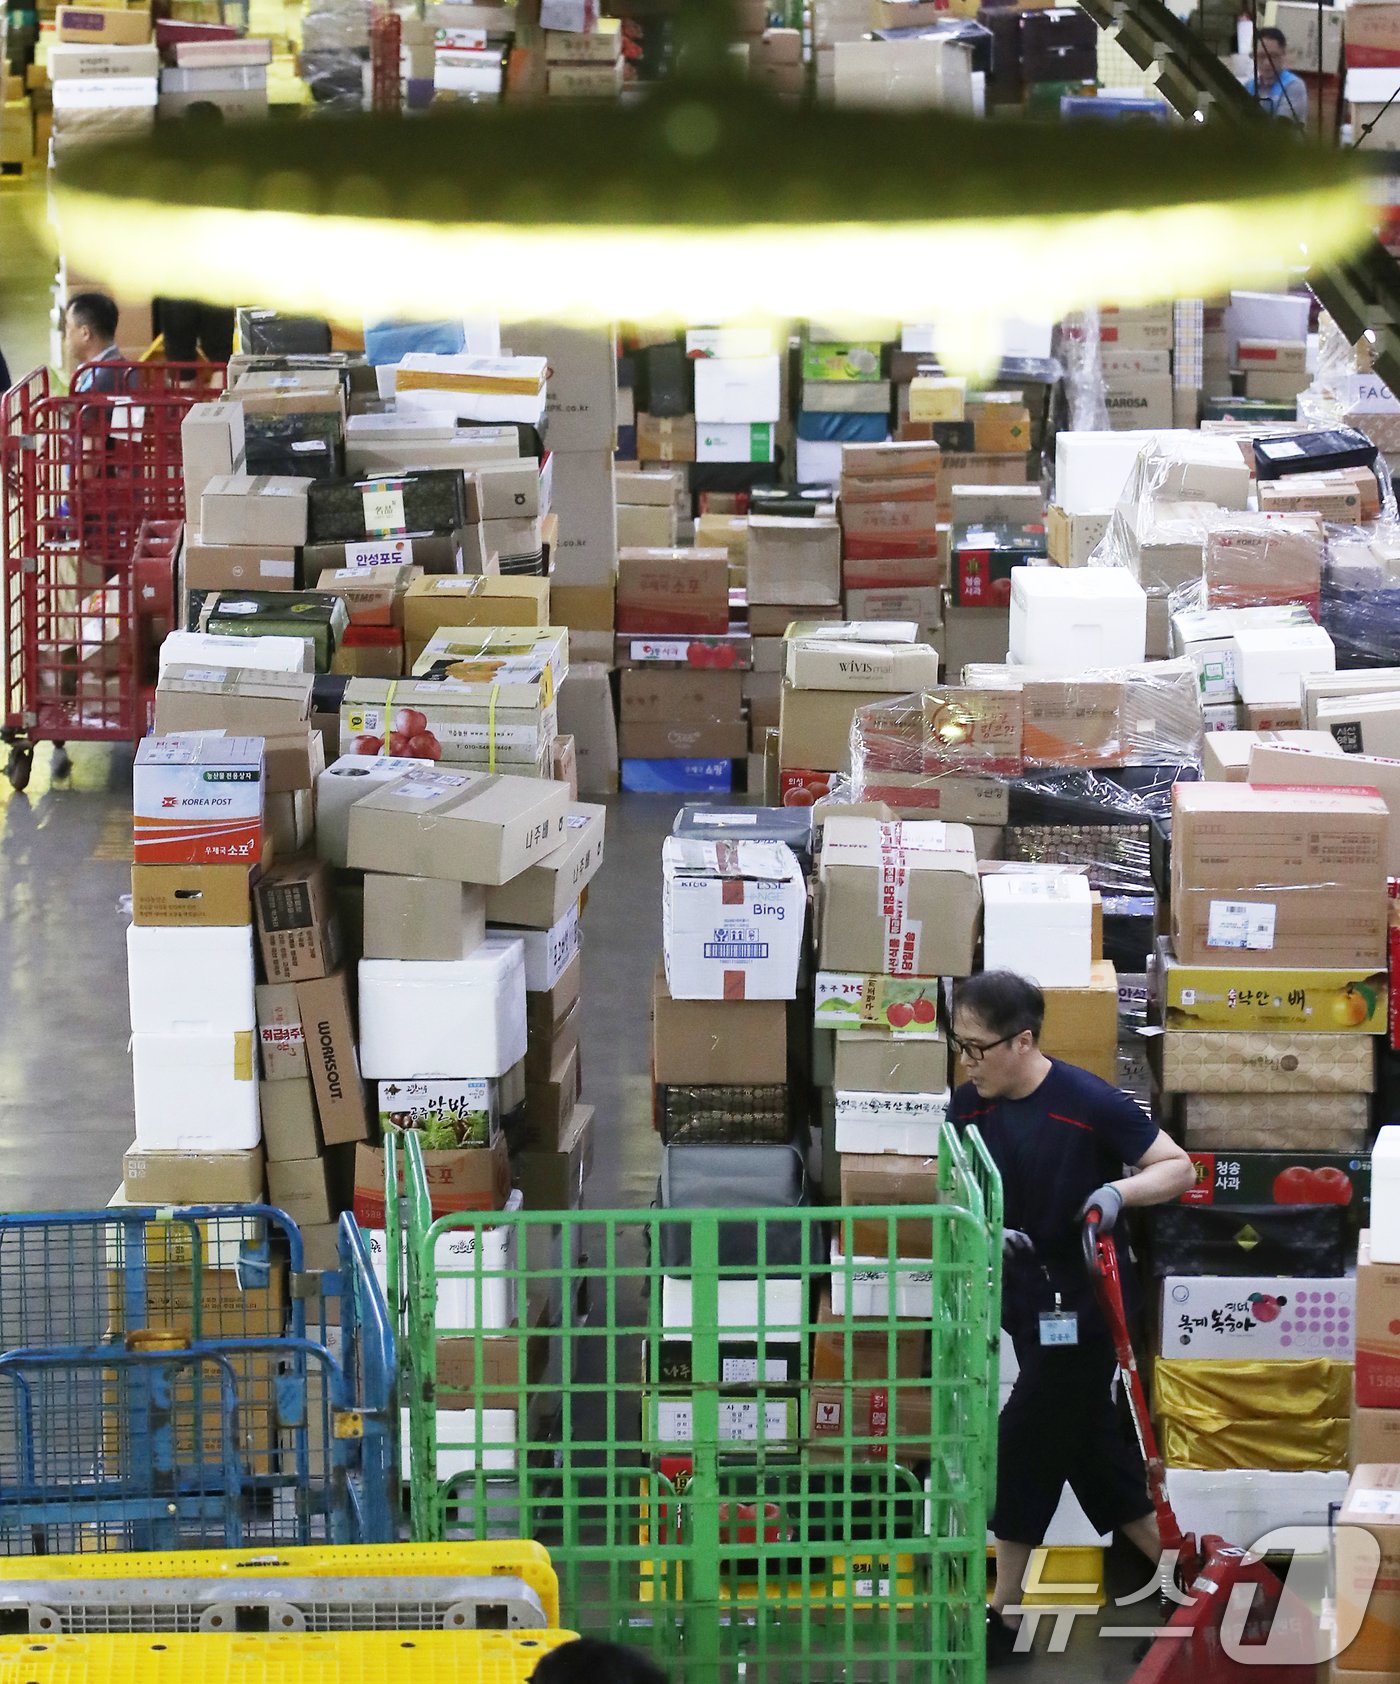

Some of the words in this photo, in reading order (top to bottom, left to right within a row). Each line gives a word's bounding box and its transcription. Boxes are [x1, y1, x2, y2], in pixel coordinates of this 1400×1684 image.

[356, 552, 403, 567] 안성포도
[207, 771, 225, 780] 농산물
[788, 776, 804, 788] 의성
[181, 798, 210, 806] KOREA
[211, 798, 233, 806] POST
[525, 818, 550, 850] 나주배
[204, 846, 227, 856] 우체국
[227, 844, 250, 857] 소포
[753, 903, 786, 921] Bing
[1238, 990, 1270, 1008] 낙안
[1288, 989, 1306, 1011] 배
[317, 1020, 344, 1100] WORKSOUT
[410, 1106, 429, 1121] 공주
[428, 1095, 473, 1122] 알밤
[1216, 1161, 1241, 1175] 청송
[1215, 1176, 1241, 1190] 사과
[1211, 1309, 1257, 1335] 복숭아
[663, 1363, 691, 1379] 나주
